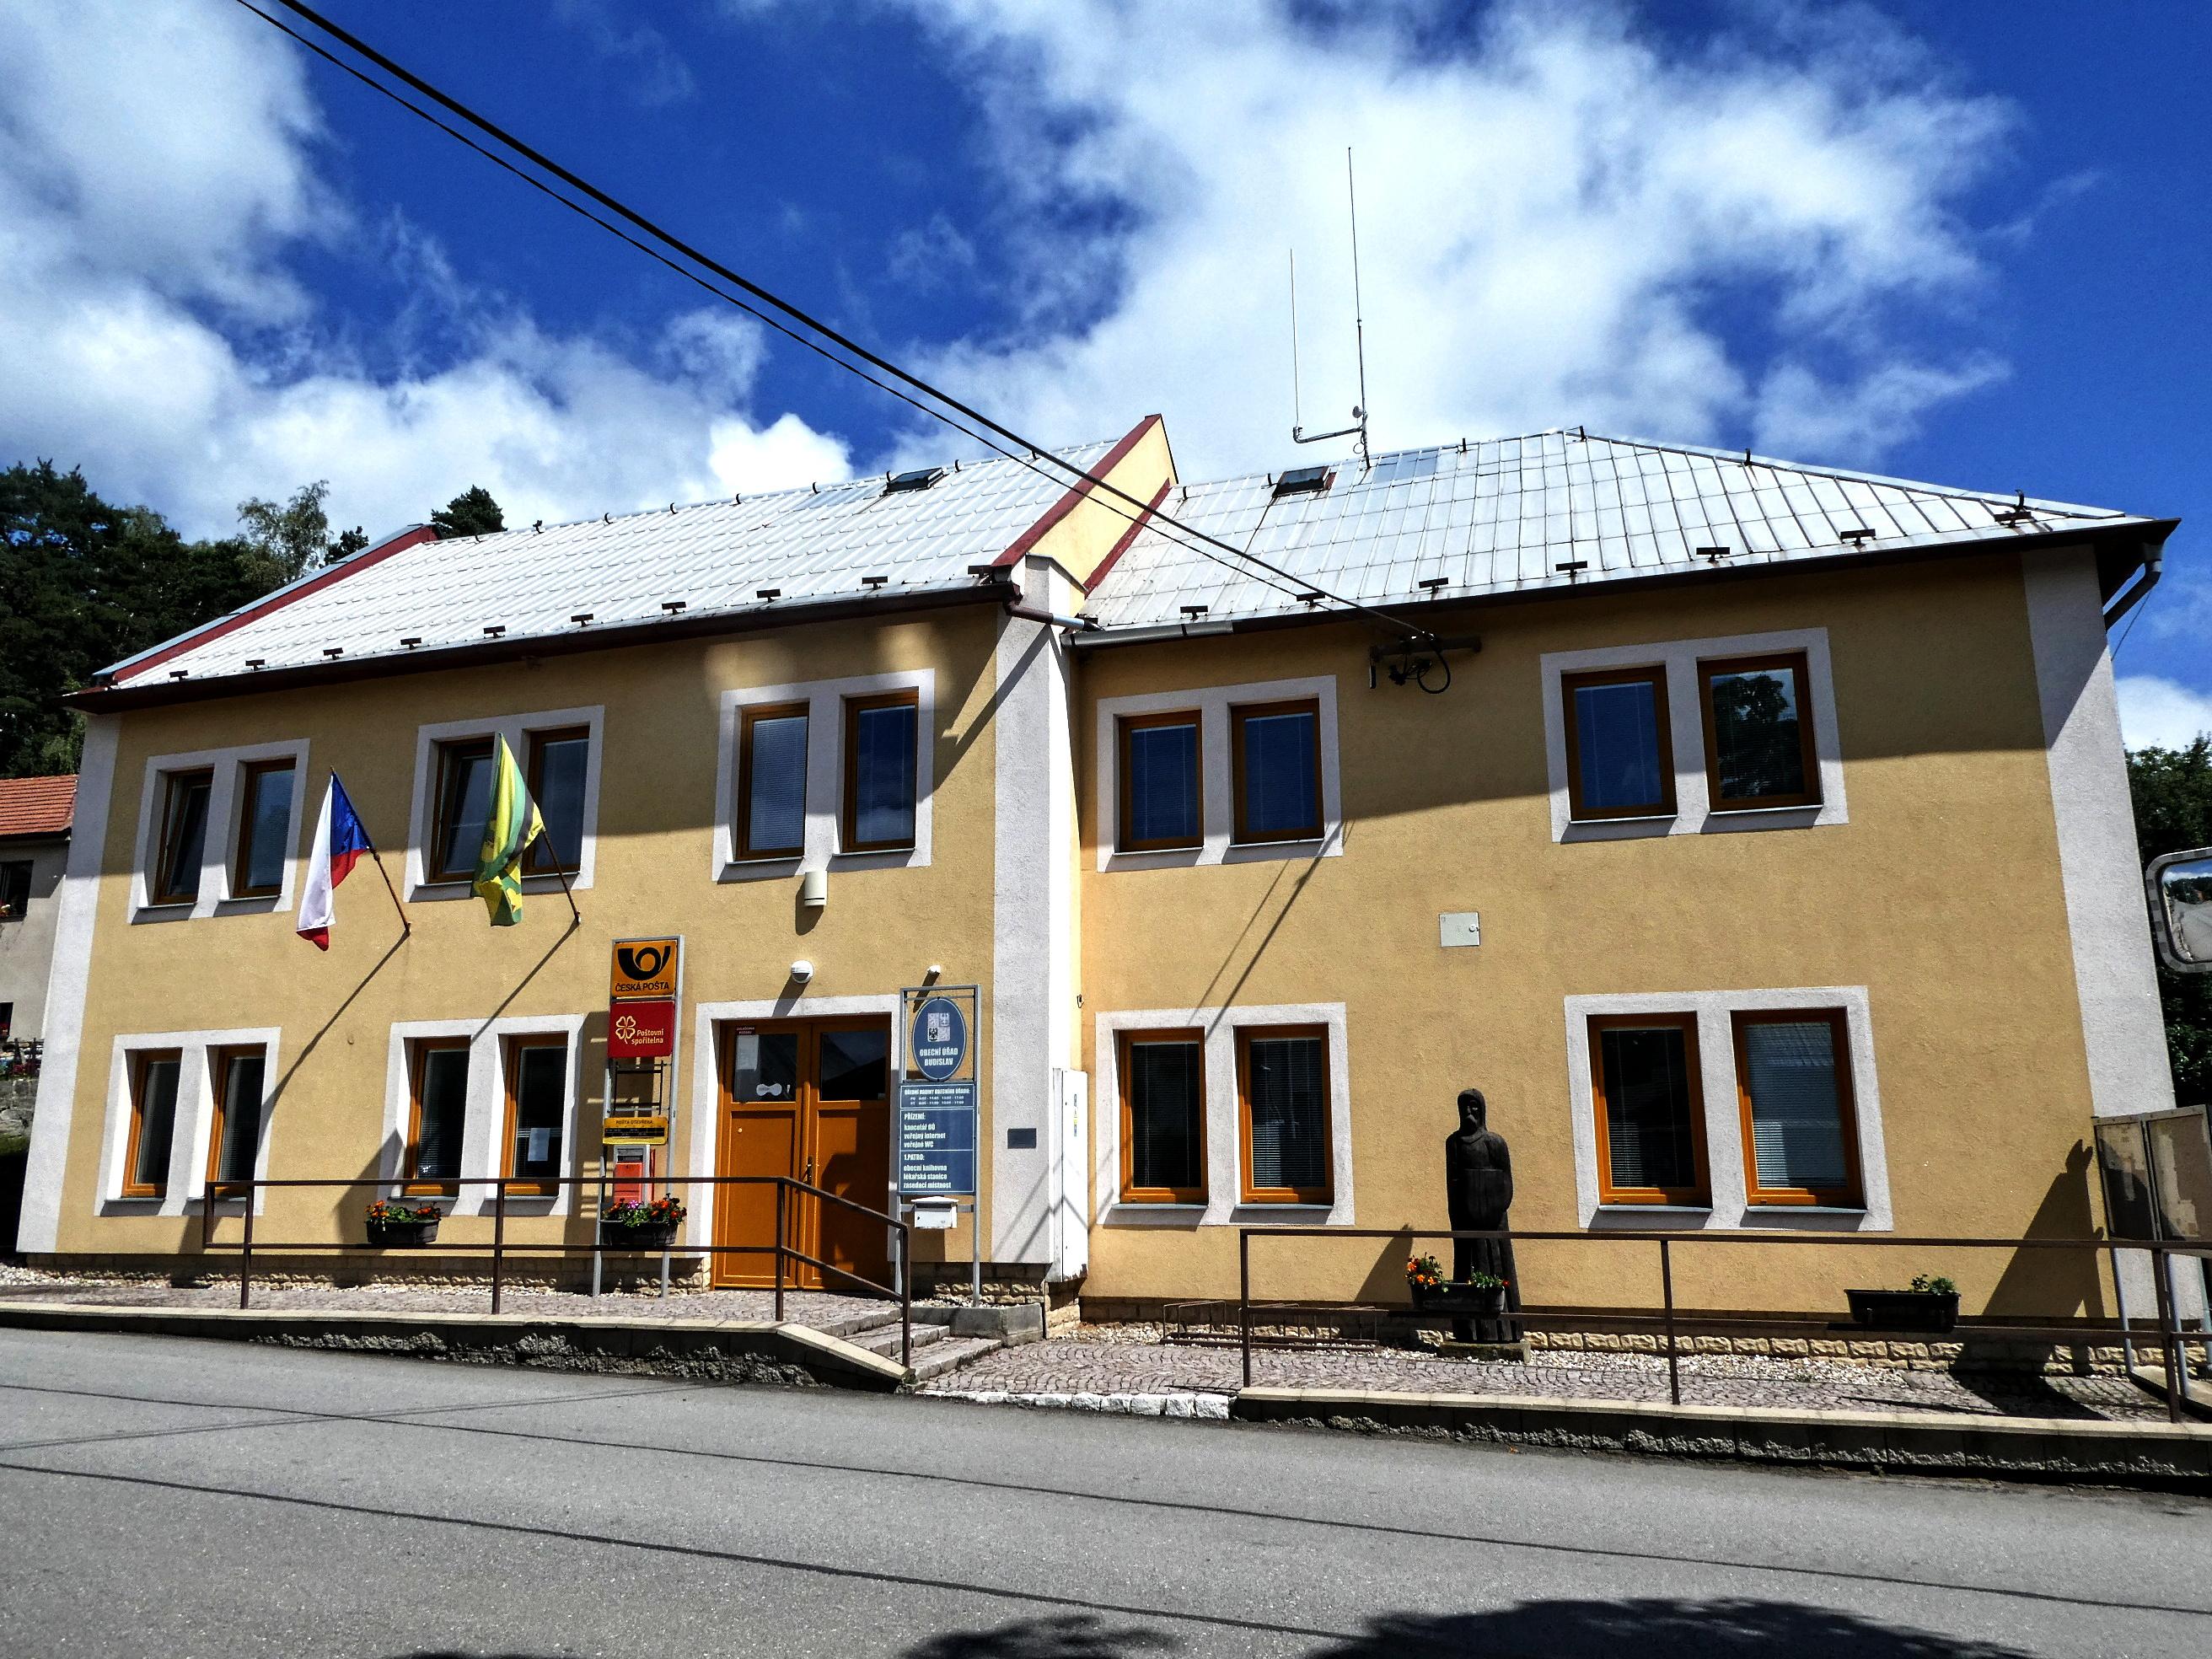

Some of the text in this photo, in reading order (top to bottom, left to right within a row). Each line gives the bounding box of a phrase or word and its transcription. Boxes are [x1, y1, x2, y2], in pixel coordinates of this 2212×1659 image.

[615, 981, 669, 991] ČESKÁ POŠTA
[636, 1028, 664, 1037] Poštovní
[631, 1037, 663, 1045] spořitelna
[919, 1048, 941, 1056] OBECNÍ
